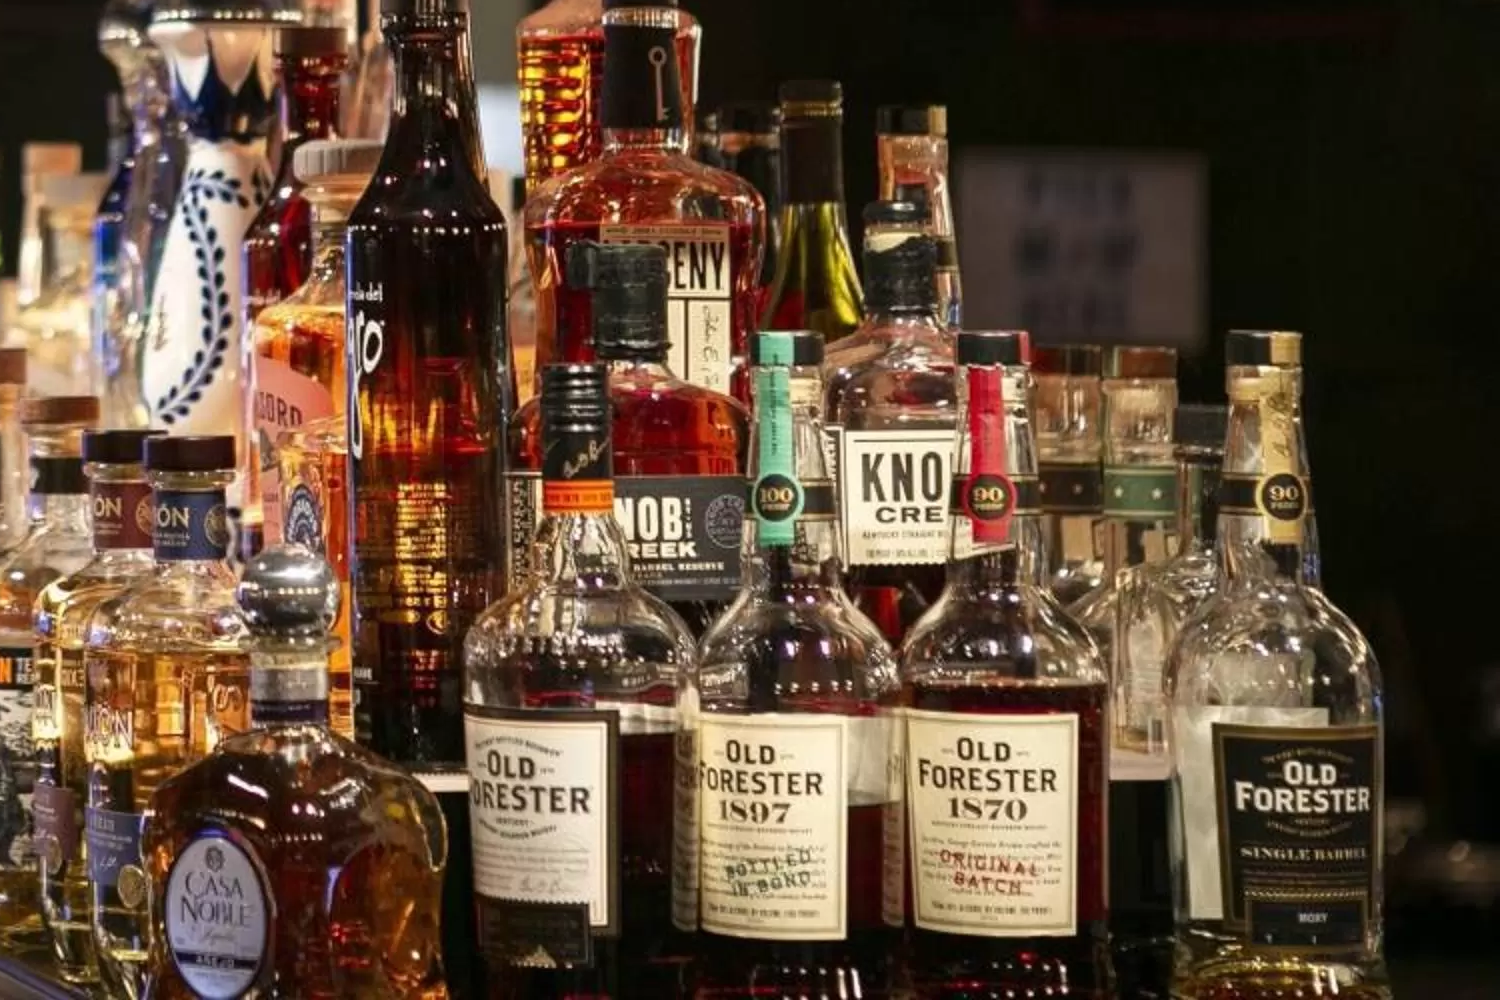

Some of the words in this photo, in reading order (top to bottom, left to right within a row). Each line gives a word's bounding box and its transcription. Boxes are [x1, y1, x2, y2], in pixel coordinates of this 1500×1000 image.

[861, 450, 953, 503] KNO
[94, 493, 123, 517] ÓN
[760, 486, 795, 502] 100
[973, 486, 1004, 501] 90
[1269, 485, 1299, 501] 90
[156, 502, 190, 528] ÓN
[613, 496, 683, 541] NOB
[875, 506, 944, 524] CRE
[628, 541, 697, 559] REEK
[725, 739, 776, 766] OLD
[956, 737, 1012, 763] OLD
[487, 749, 535, 780] OLD
[918, 758, 1058, 793] FORESTER
[1282, 759, 1338, 786] OLD
[471, 779, 591, 815] ORESTER
[948, 797, 1029, 822] 1870
[1233, 780, 1371, 814] FORESTER
[719, 799, 792, 825] 1897
[725, 850, 811, 881] BOTTLED
[939, 849, 1039, 877] ORIGINAL
[1240, 847, 1311, 861] SINGLE
[184, 871, 245, 900] CASA
[953, 871, 1022, 896] BATCH
[180, 895, 256, 927] NOBLE
